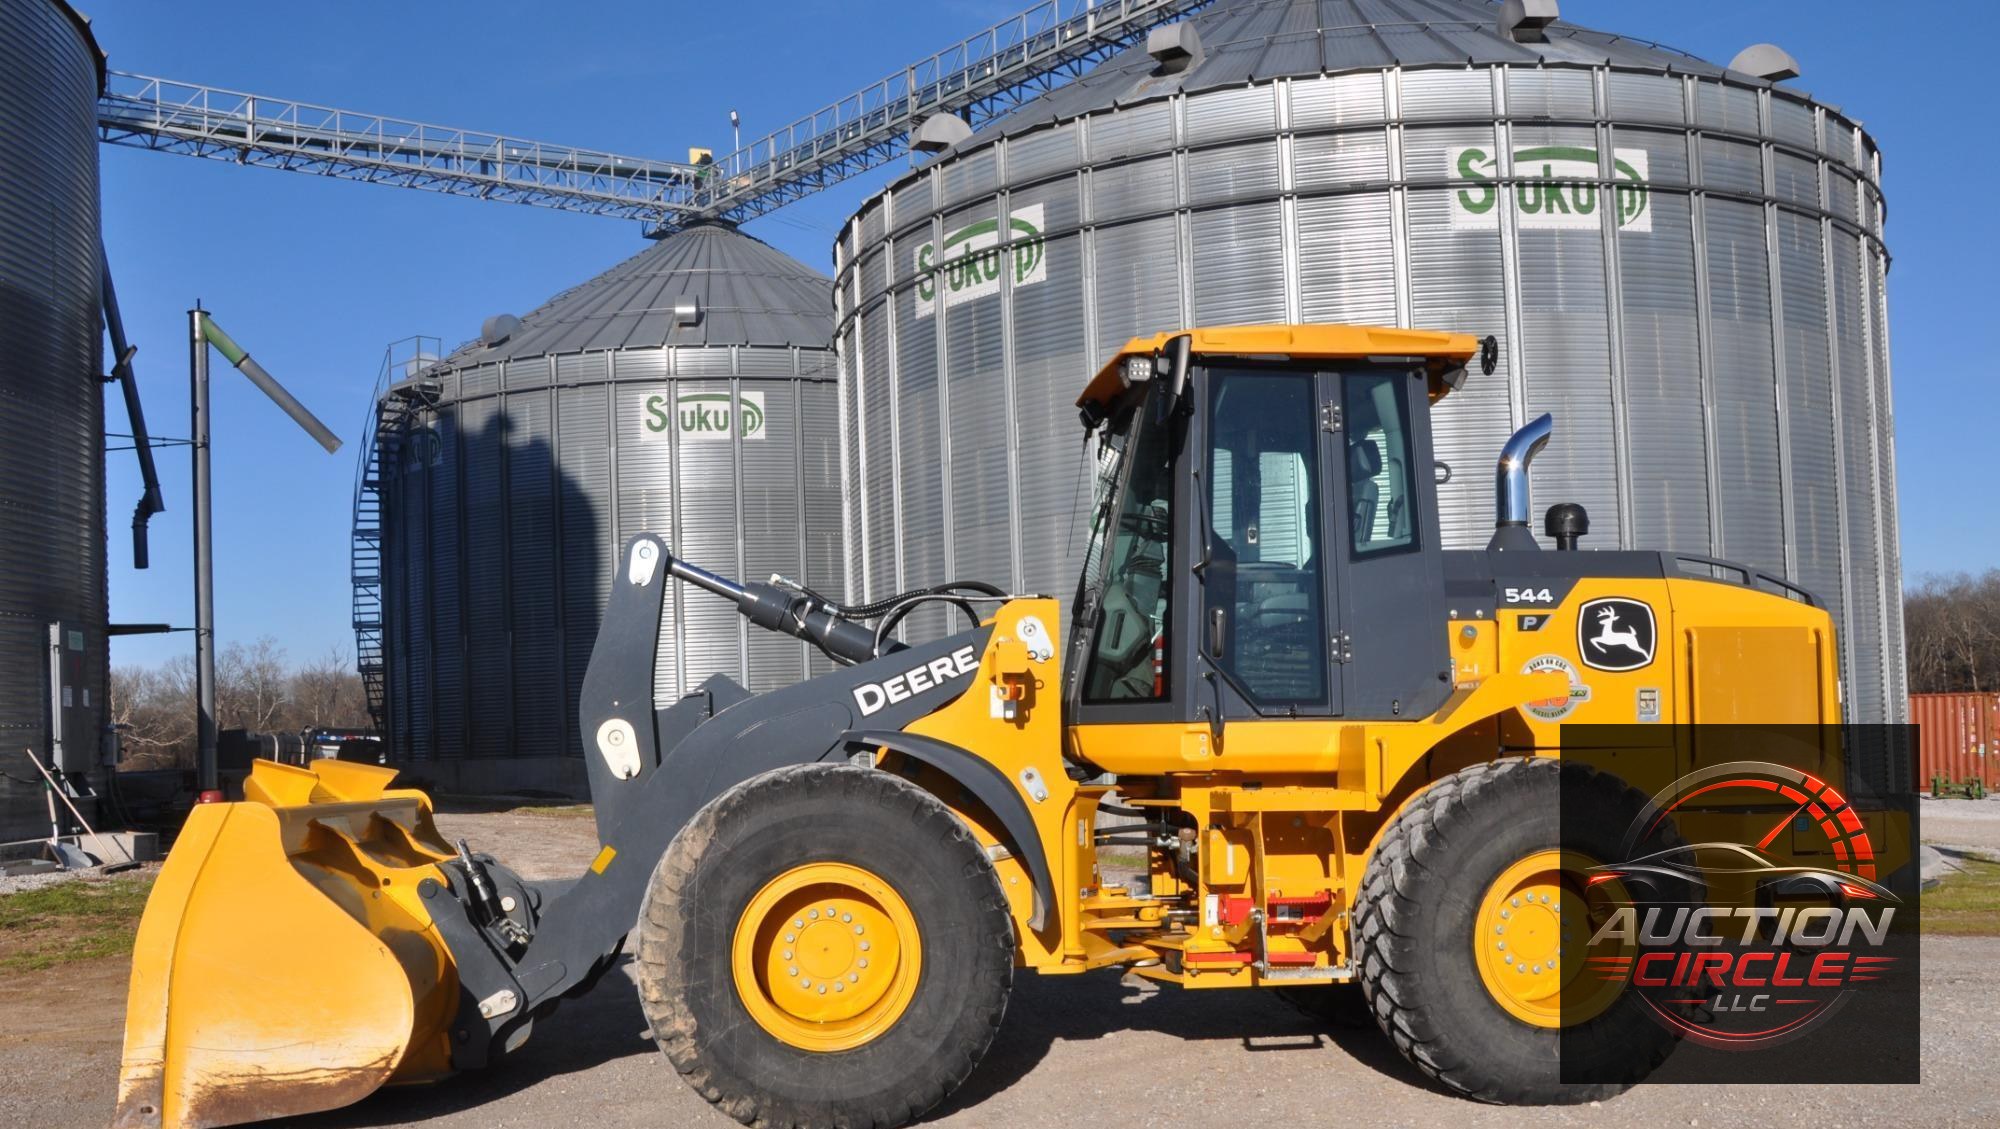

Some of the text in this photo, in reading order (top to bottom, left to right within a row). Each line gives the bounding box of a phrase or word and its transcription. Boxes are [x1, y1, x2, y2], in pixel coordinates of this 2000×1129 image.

[1457, 147, 1647, 226] Sukup
[917, 217, 1044, 301] Sukup
[645, 393, 763, 437] Sukup
[1505, 588, 1554, 603] 544
[1522, 616, 1538, 631] P
[852, 645, 981, 717] DEERE
